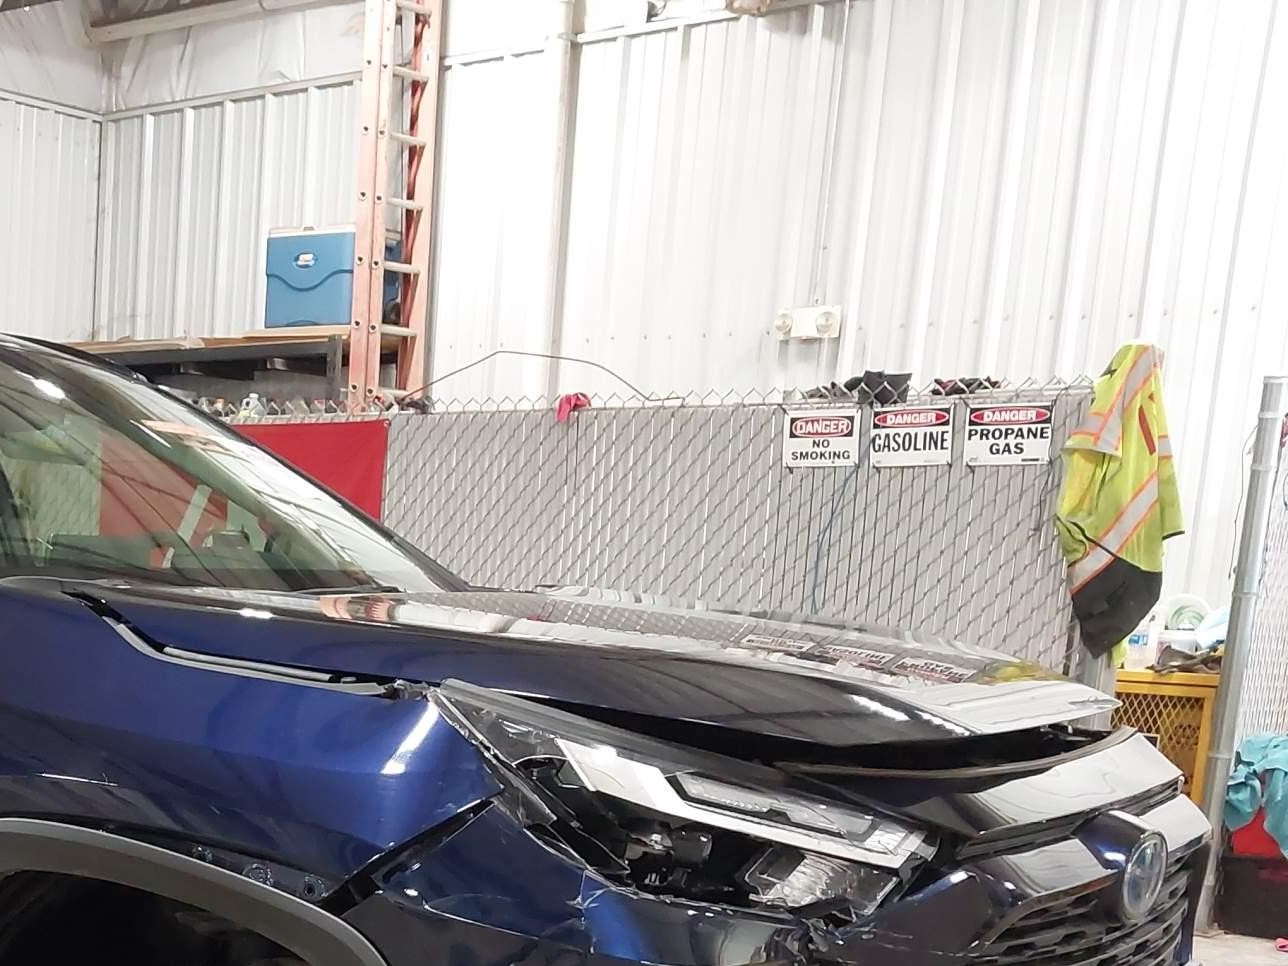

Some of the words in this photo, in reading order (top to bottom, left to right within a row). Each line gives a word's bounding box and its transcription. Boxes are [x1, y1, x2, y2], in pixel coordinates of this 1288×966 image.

[886, 412, 936, 425] DANGER
[983, 409, 1036, 422] DANGER
[796, 418, 848, 434] DANGER
[968, 426, 1050, 441] PROPANE
[812, 439, 830, 448] NO
[872, 431, 949, 453] GASOLINE
[989, 442, 1024, 455] GAS
[791, 450, 850, 461] SMOKING
